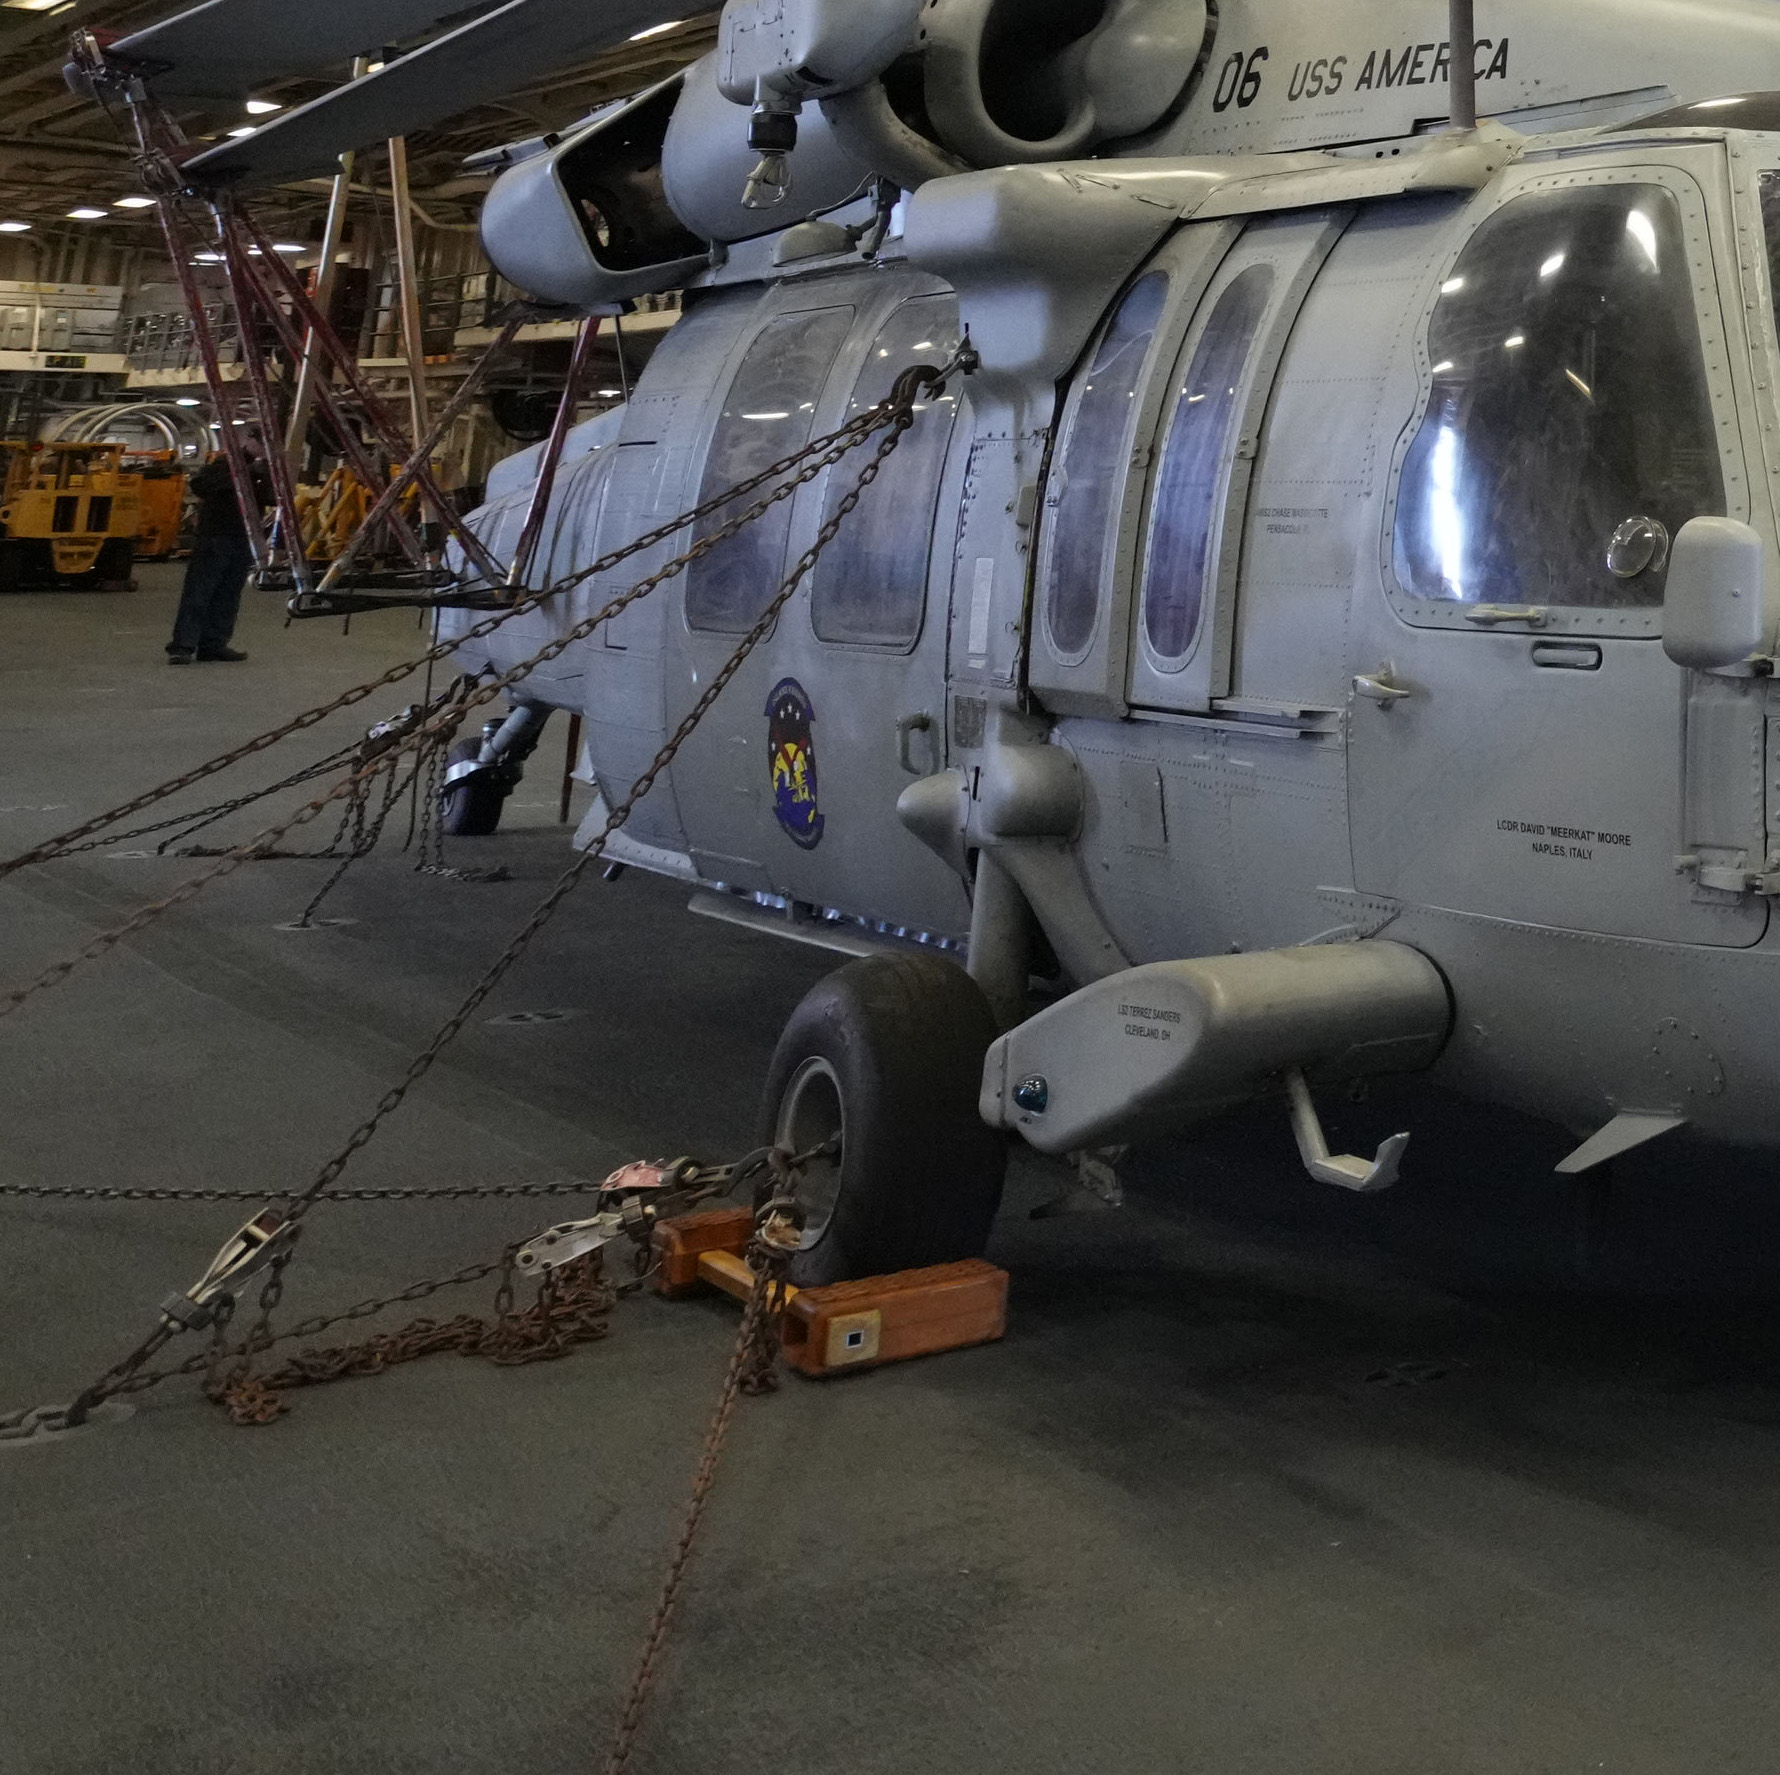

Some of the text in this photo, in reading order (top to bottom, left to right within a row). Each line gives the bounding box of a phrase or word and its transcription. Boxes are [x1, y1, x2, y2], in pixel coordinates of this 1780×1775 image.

[1212, 37, 1510, 113] 06 USS AMERCA
[1496, 819, 1632, 847] LCDR DAVID "MEERKAT" MOORE
[1569, 846, 1593, 861] ITALY
